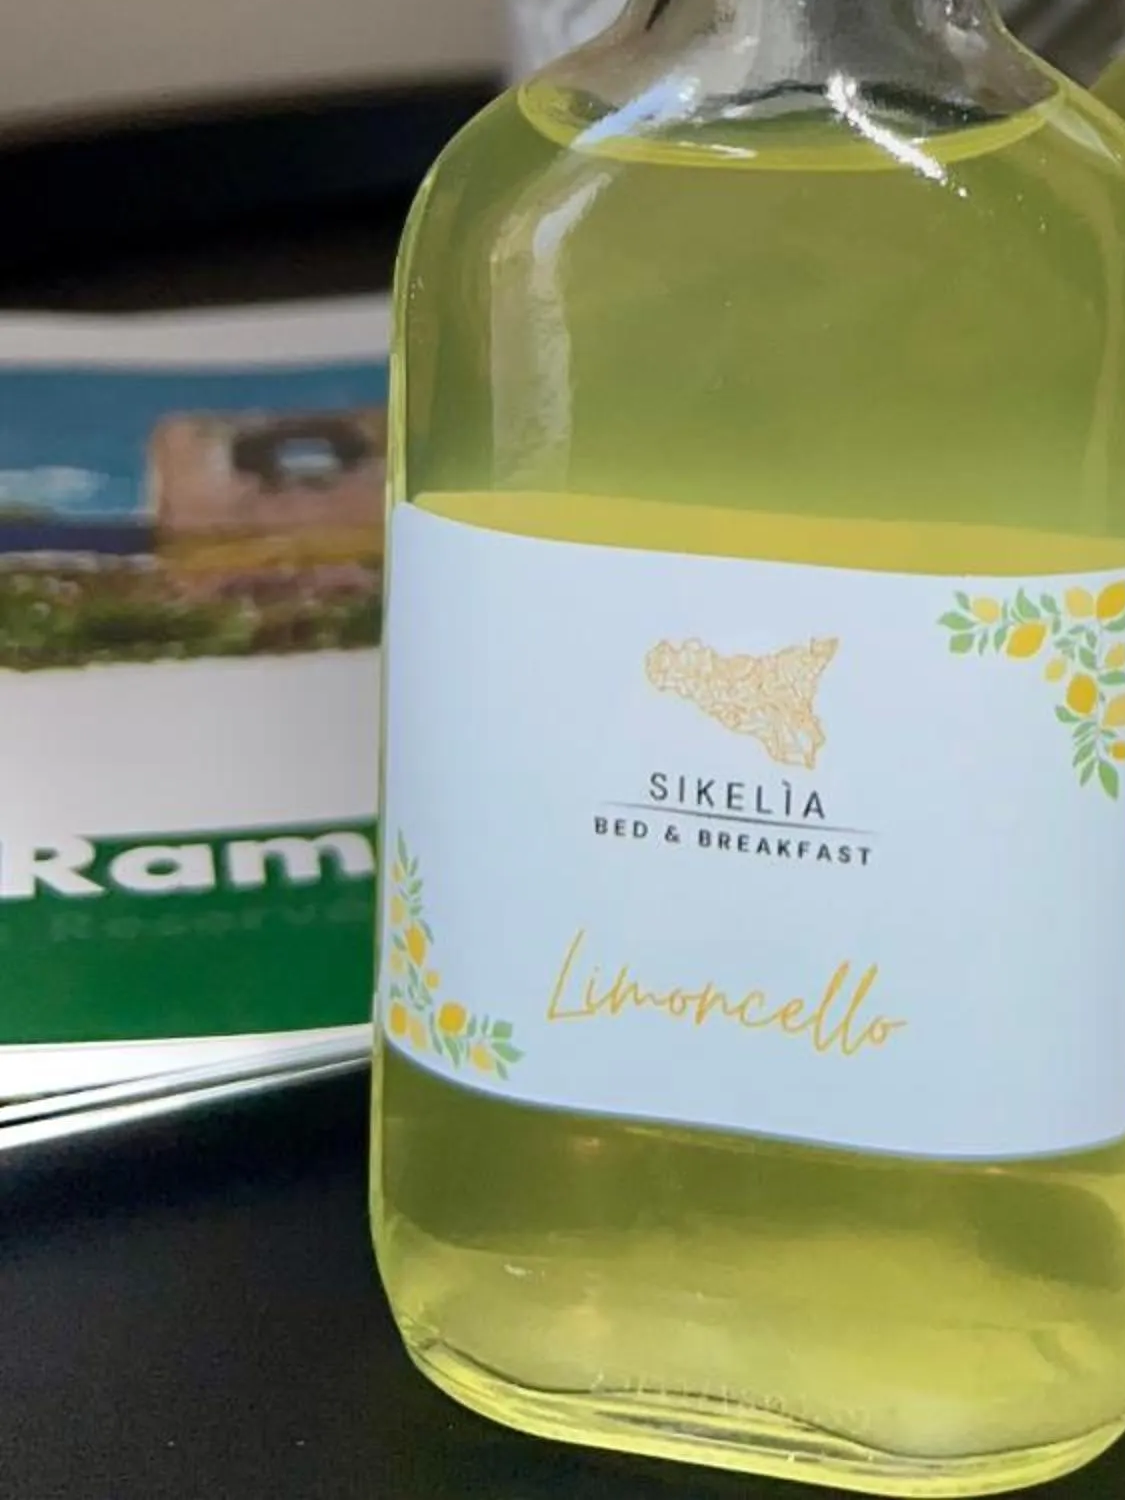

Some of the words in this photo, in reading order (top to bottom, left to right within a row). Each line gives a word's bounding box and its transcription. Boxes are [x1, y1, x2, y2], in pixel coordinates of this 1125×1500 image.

[0, 831, 374, 898] Ram
[593, 816, 650, 841] BED
[663, 825, 682, 844] &
[697, 829, 874, 867] BREAKFAST
[546, 929, 907, 1057] Limoncello
